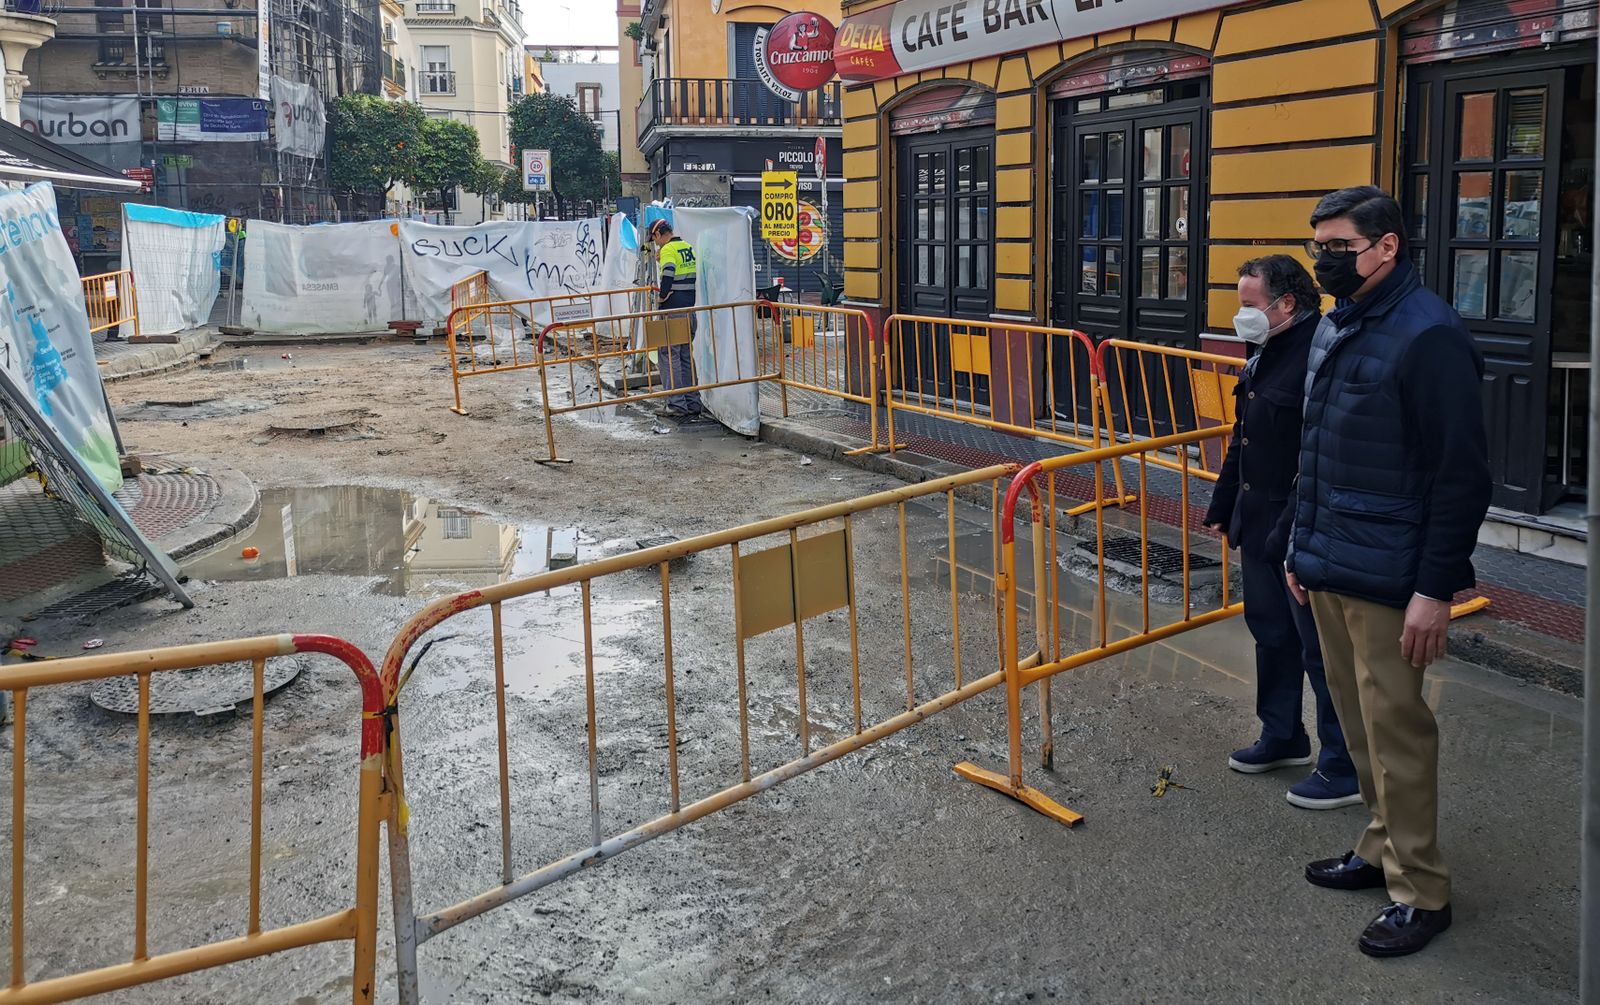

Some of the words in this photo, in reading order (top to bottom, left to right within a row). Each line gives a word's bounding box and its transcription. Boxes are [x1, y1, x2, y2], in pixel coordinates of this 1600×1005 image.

[983, 0, 1049, 35] BAR
[755, 34, 763, 45] LA
[840, 23, 885, 52] DELTA
[770, 50, 834, 65] Cruzcampo
[850, 56, 874, 67] CAFÉS
[755, 47, 772, 84] TOSTAITA
[179, 86, 208, 94] FERIA
[771, 83, 793, 100] VELOZ
[779, 151, 813, 163] PICCOLO
[683, 163, 716, 171] FERIA
[764, 192, 794, 200] COMPRO
[764, 202, 794, 221] ORO
[412, 233, 519, 267] SUCK
